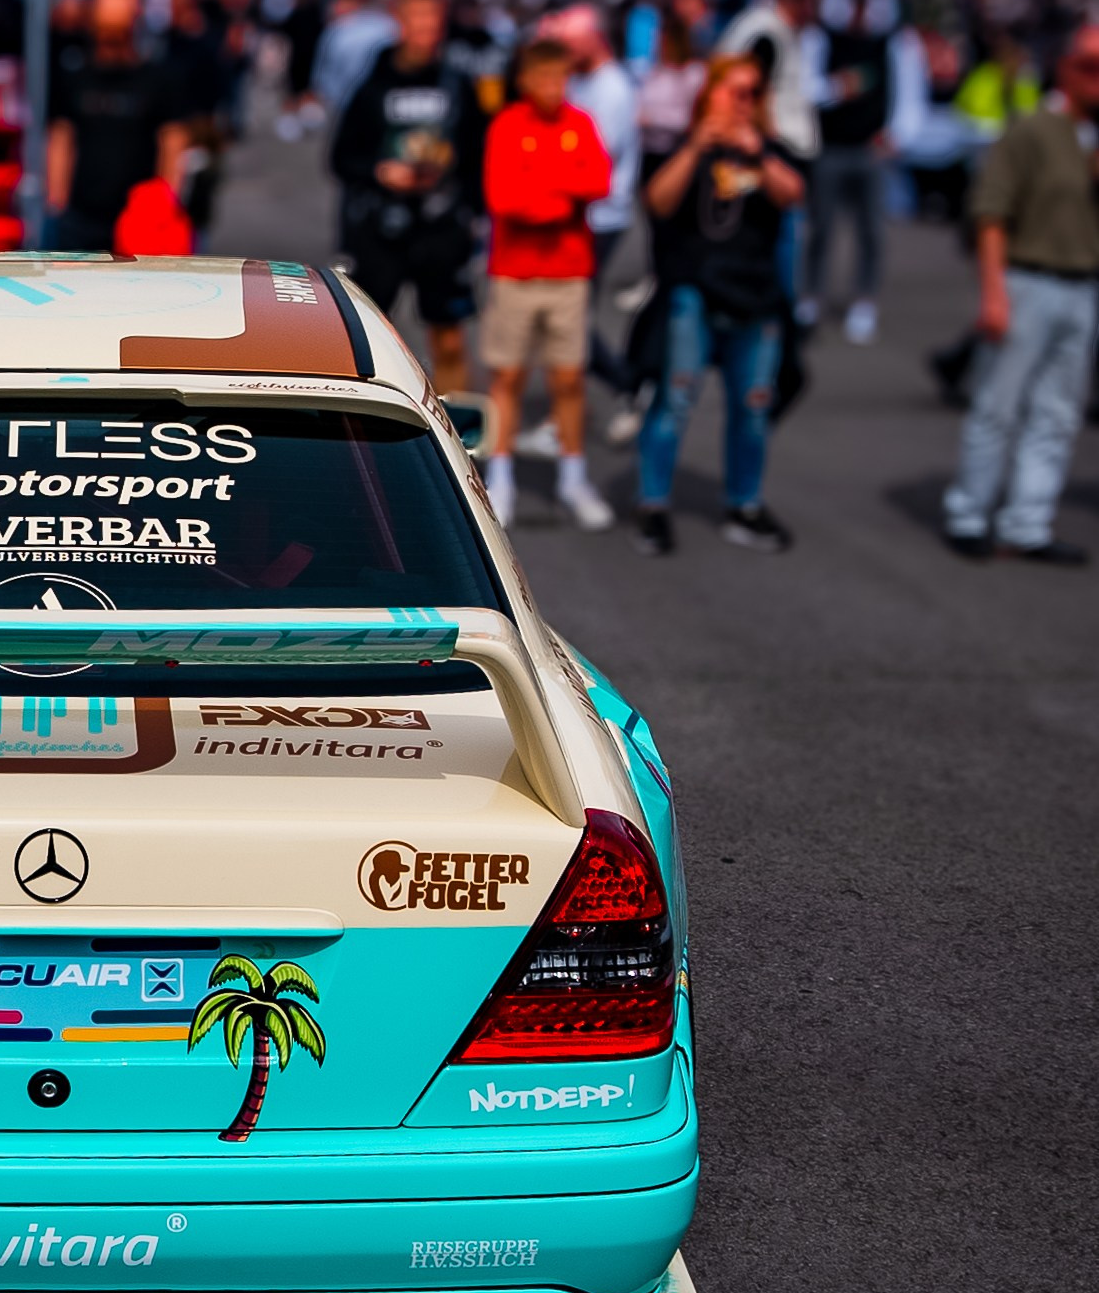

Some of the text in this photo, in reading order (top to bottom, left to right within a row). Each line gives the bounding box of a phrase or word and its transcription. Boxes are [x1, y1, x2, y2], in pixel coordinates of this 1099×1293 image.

[414, 853, 530, 884] FETTER
[408, 880, 506, 910] FOGEL
[412, 1239, 540, 1254] REISEGRUPPE
